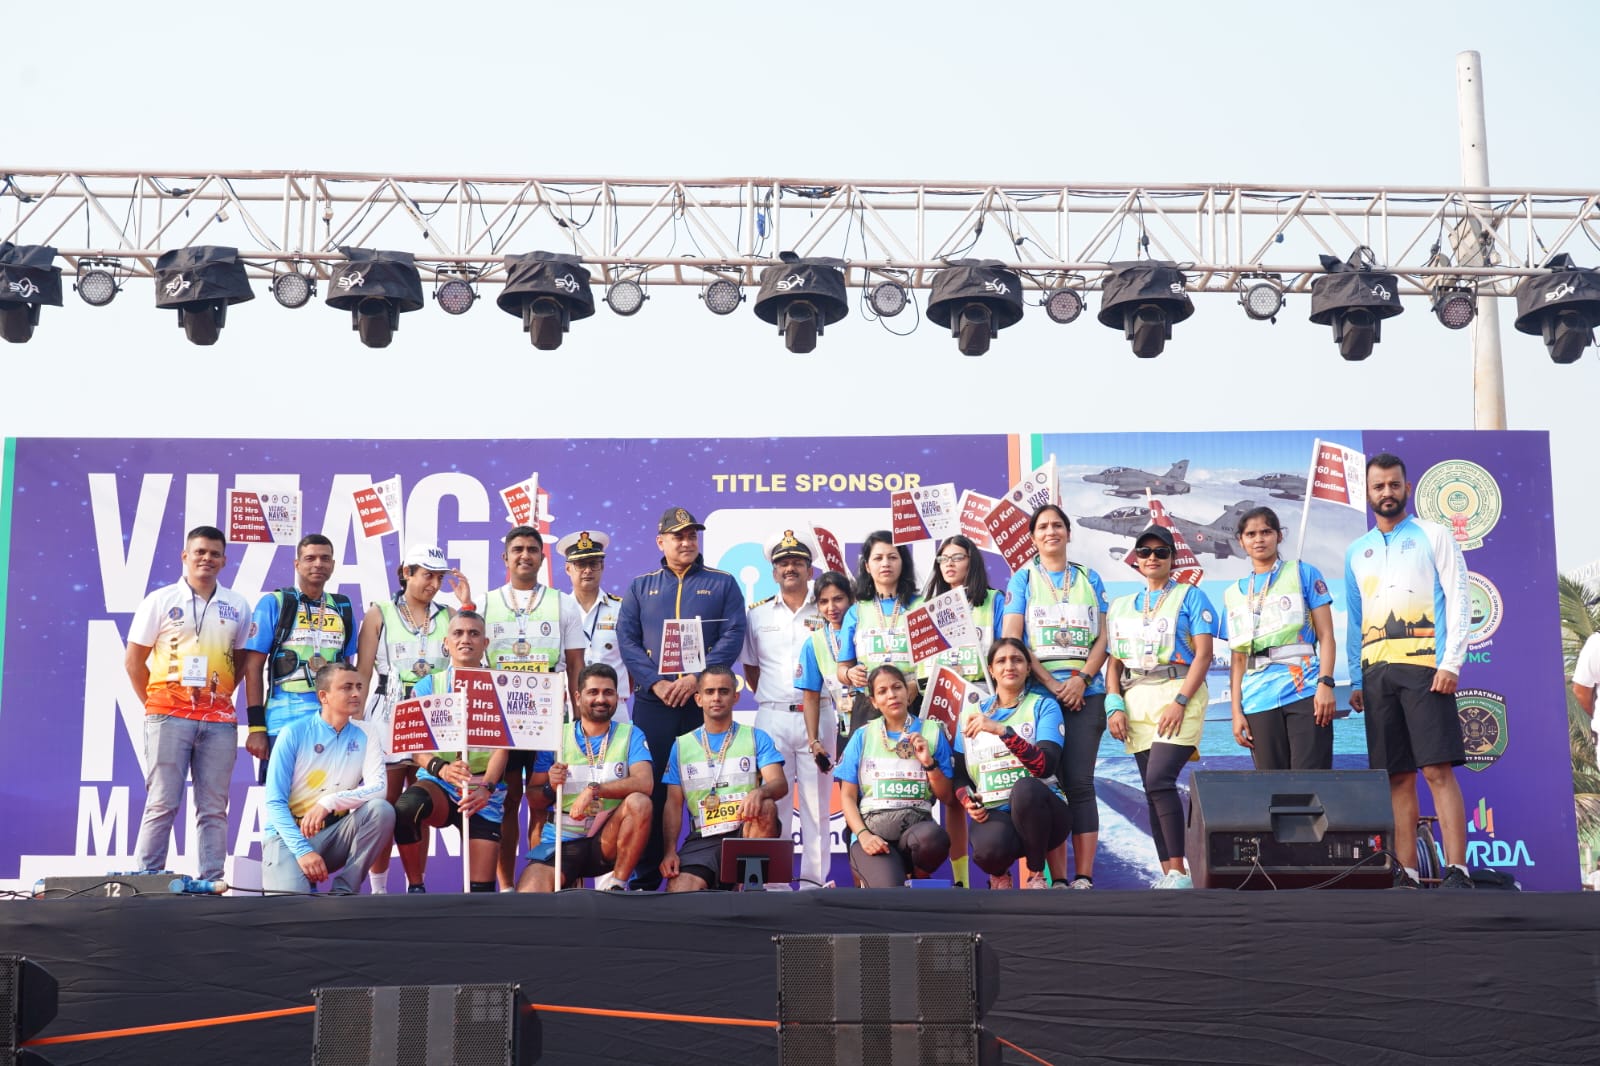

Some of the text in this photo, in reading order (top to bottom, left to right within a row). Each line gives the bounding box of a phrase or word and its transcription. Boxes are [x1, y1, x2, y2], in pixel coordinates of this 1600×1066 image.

[1321, 452, 1330, 460] 10
[1317, 465, 1329, 474] 60
[712, 473, 921, 493] TITLE SPONSOR
[1027, 488, 1048, 506] VIZAG
[967, 500, 977, 508] 10
[245, 506, 259, 514] Hrs
[360, 508, 370, 517] 90
[963, 511, 974, 519] 70
[894, 512, 903, 520] 70
[988, 519, 1000, 532] 10
[999, 505, 1016, 522] Km
[232, 523, 266, 531] Guntime
[894, 525, 922, 534] Guntime
[995, 516, 1028, 546] 80 Mins
[1017, 554, 1024, 563] 2
[1025, 543, 1038, 557] mi
[1174, 555, 1195, 565] min
[917, 613, 928, 622] Km
[910, 629, 920, 639] 90
[912, 634, 939, 650] Guntime
[1469, 640, 1493, 651] Destiny
[925, 646, 938, 655] min
[1463, 652, 1491, 663] MC
[454, 679, 493, 691] 21 Km
[938, 677, 952, 690] 10
[507, 691, 529, 701] VIZAG
[1454, 690, 1503, 702] AKHAPATNAM
[473, 699, 494, 709] Hrs
[507, 700, 530, 711] NAVY
[932, 695, 948, 709] 80
[396, 705, 421, 716] 21 Km
[431, 710, 448, 718] VIZAG
[472, 712, 501, 722] mins
[395, 721, 407, 730] 02
[408, 719, 425, 728] Hrs
[394, 731, 428, 741] Guntime
[468, 727, 501, 738] ntime
[408, 742, 424, 750] min
[986, 770, 1026, 786] 14951
[879, 783, 920, 795] 14946
[1434, 839, 1535, 867] RDA
[103, 882, 121, 898] 12
